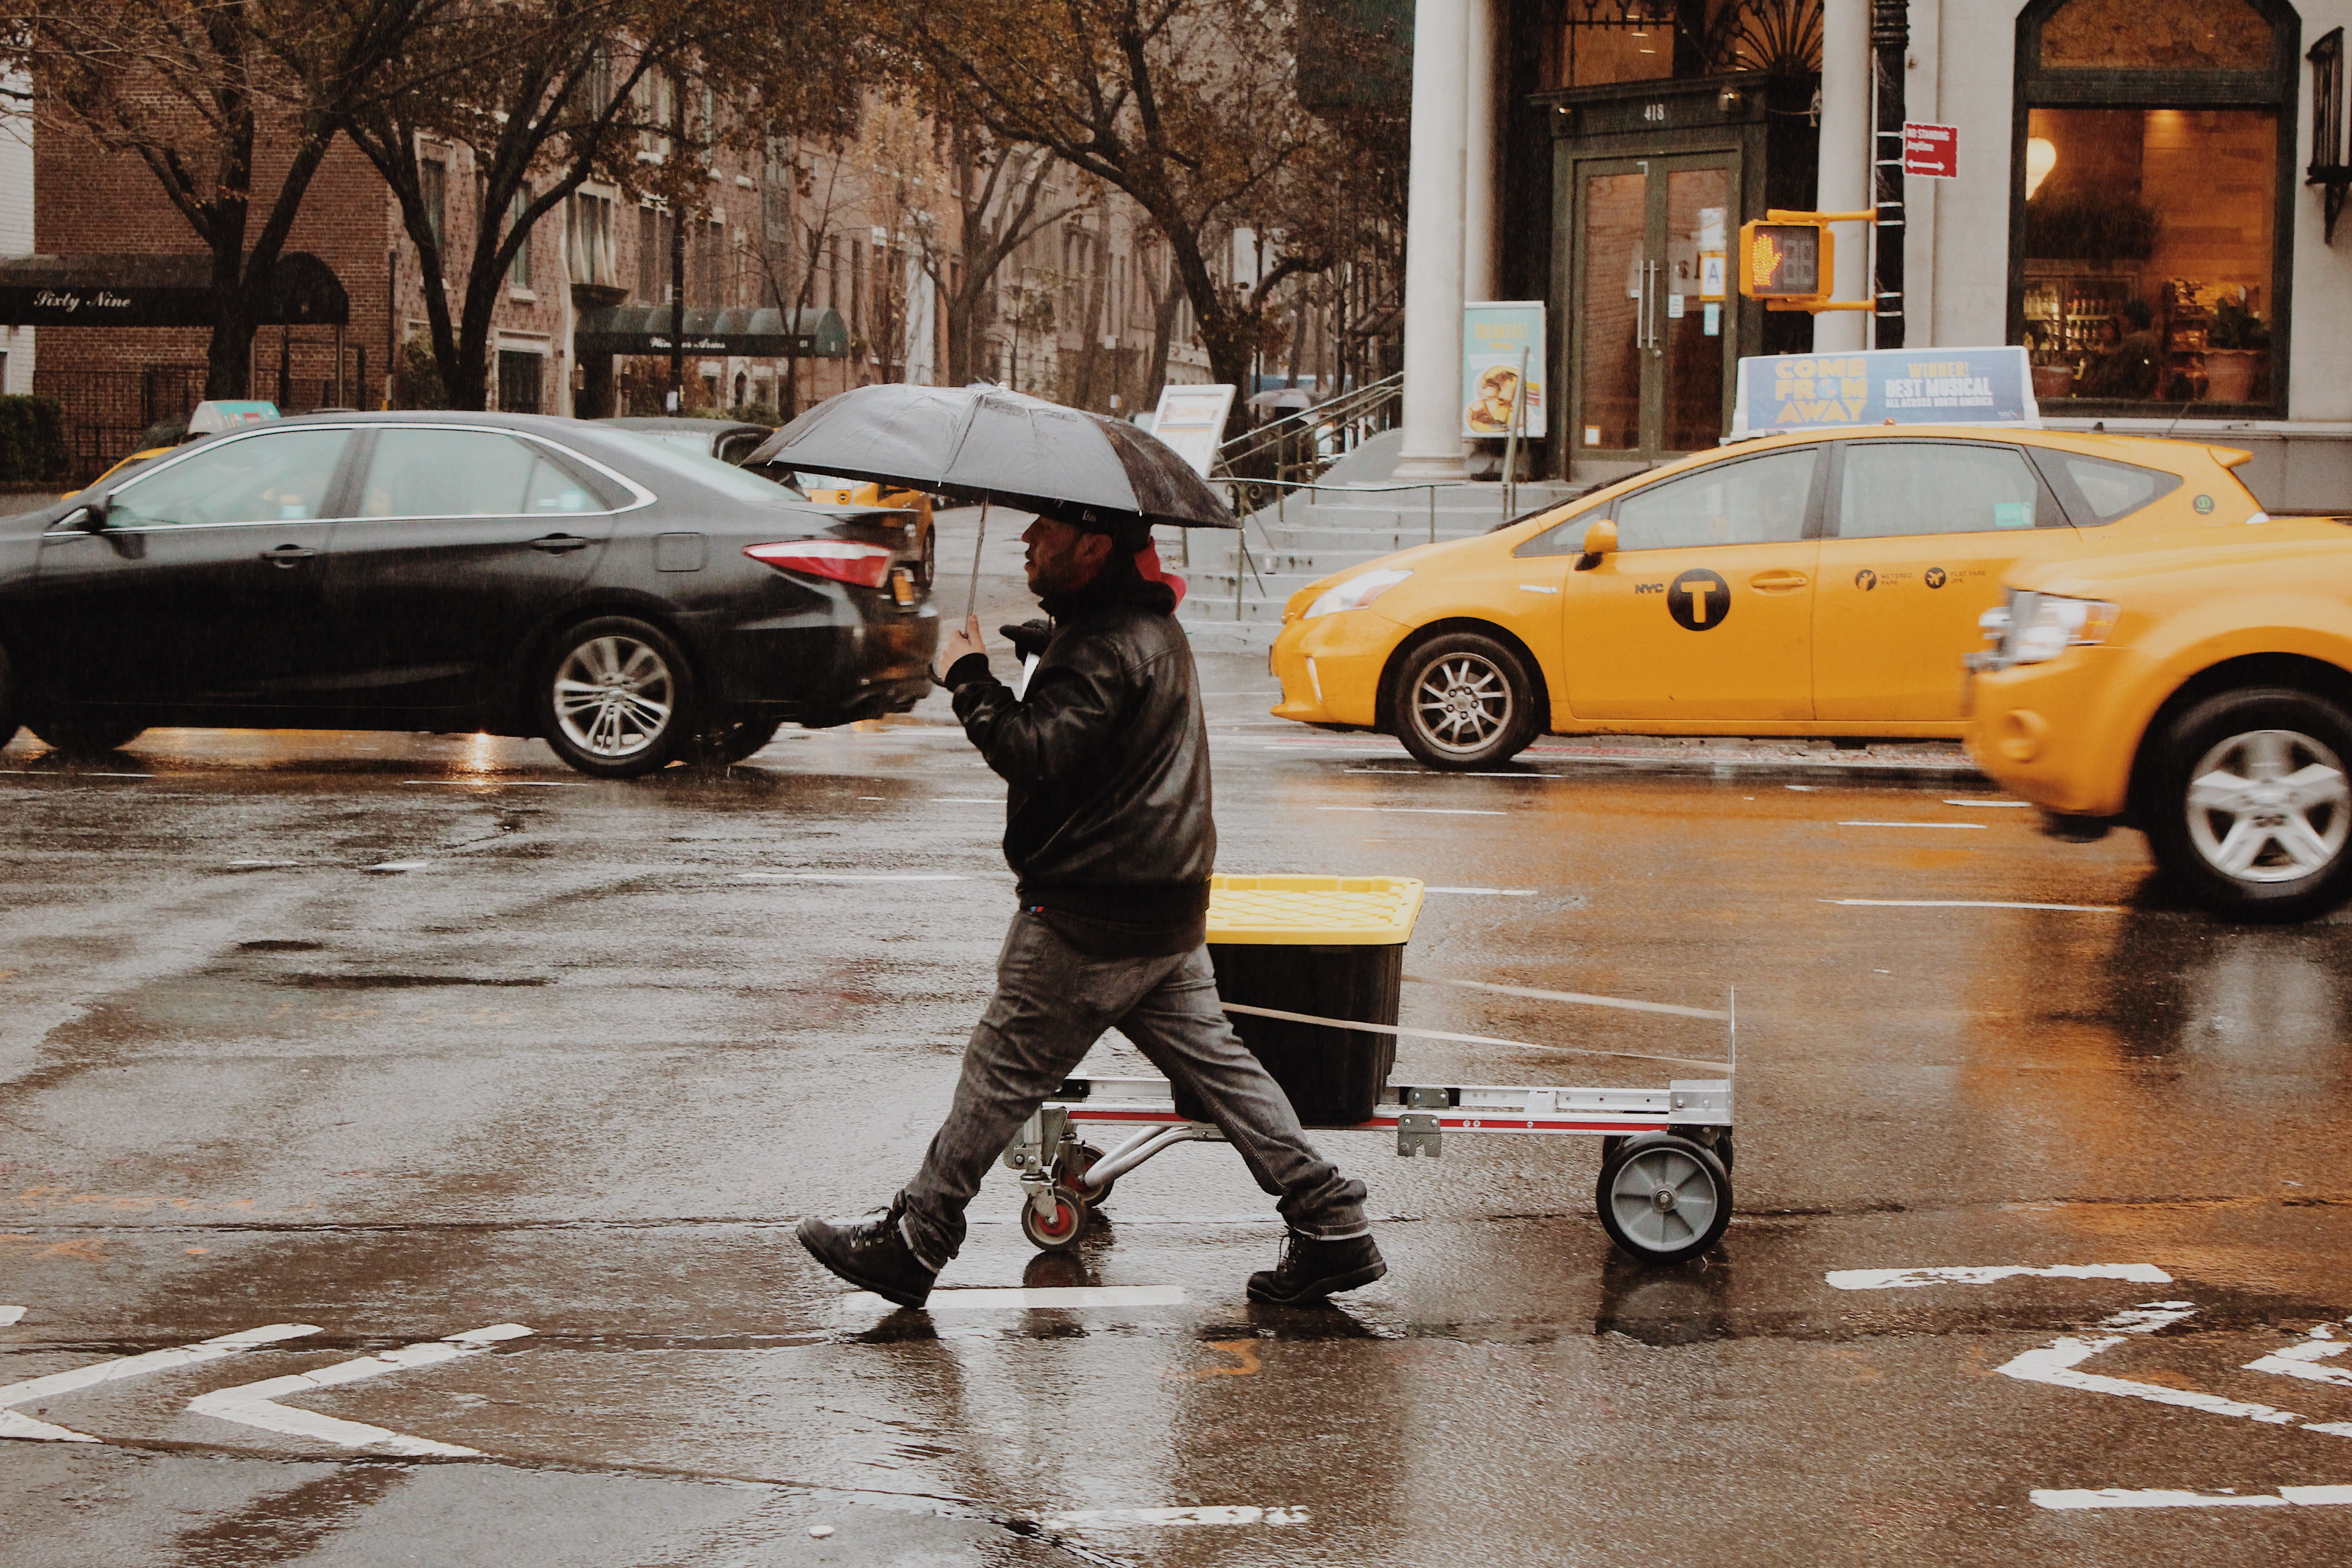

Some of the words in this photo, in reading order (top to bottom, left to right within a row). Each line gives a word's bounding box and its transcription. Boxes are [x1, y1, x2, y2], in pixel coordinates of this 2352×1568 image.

[1644, 103, 1665, 121] 418
[1906, 128, 1917, 138] NO
[1917, 128, 1950, 141] STANDING
[1707, 262, 1720, 284] A
[33, 290, 80, 312] Sixty
[86, 291, 131, 307] Nine
[1775, 358, 1866, 379] COME
[1907, 362, 1970, 377] WINNER!
[1885, 378, 1923, 398] BEST
[1925, 377, 1993, 397] MUSICAL
[1774, 399, 1867, 423] AWAY
[1885, 398, 1900, 408] ALL
[1635, 583, 1664, 593] NYC
[1680, 580, 1717, 623] T
